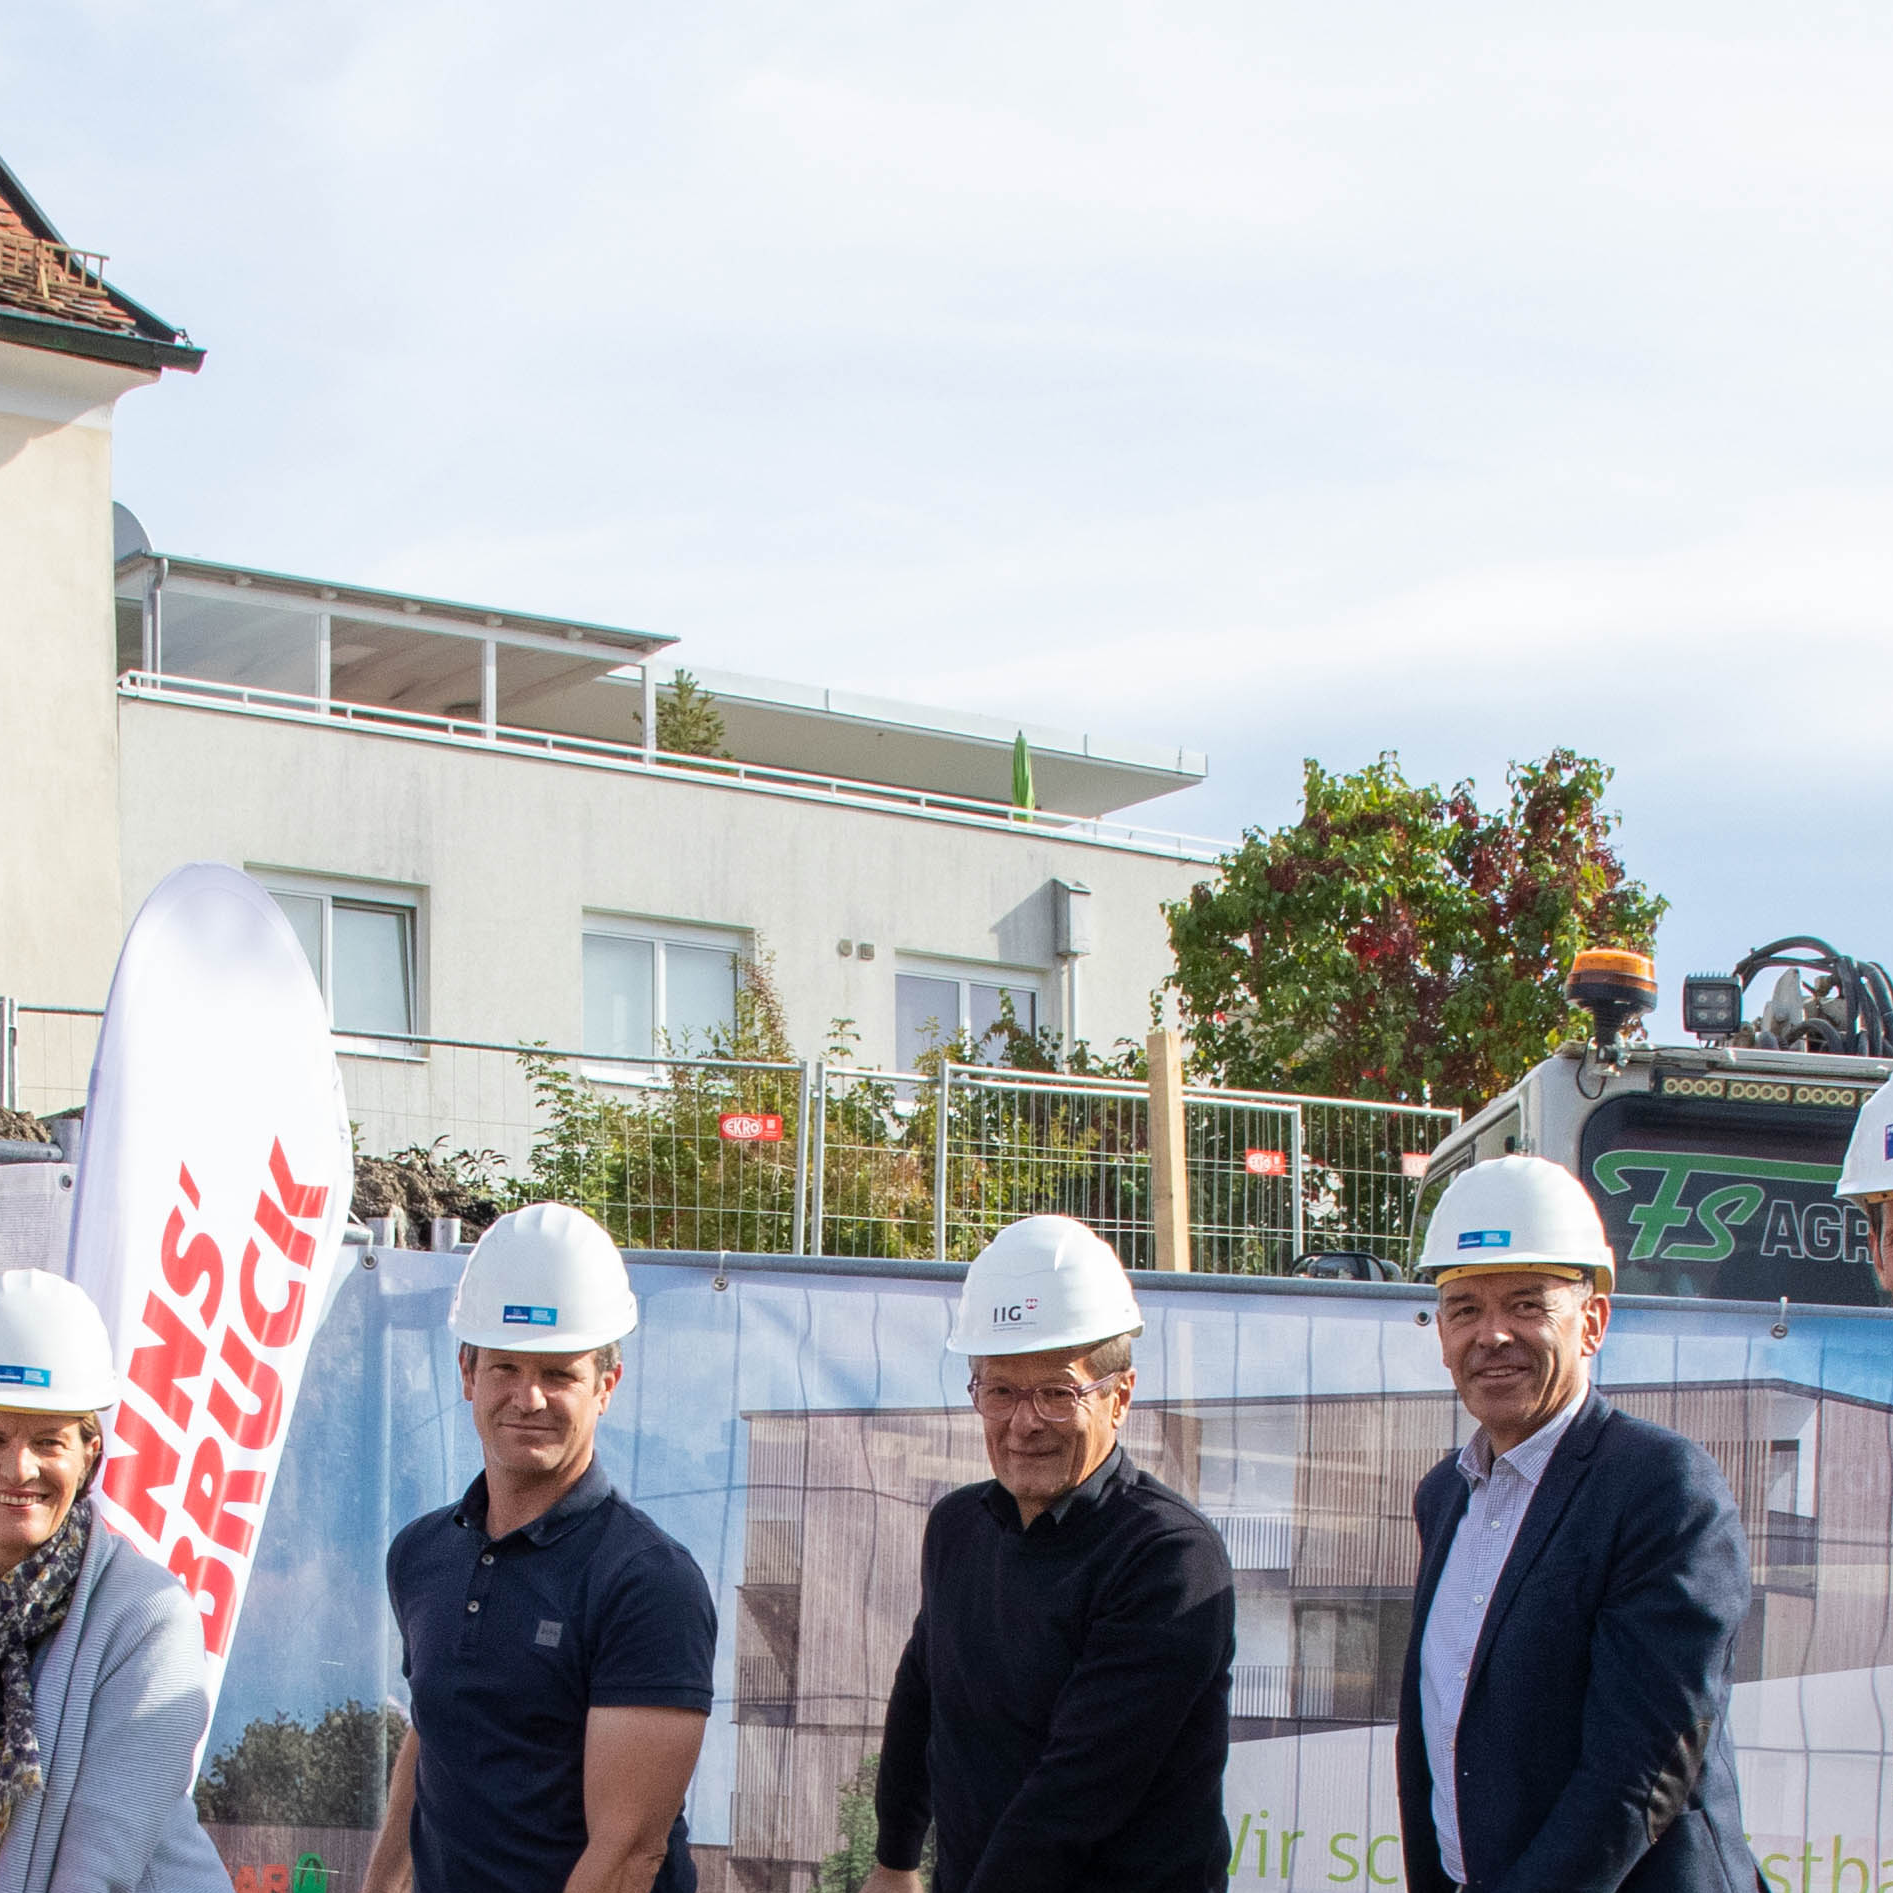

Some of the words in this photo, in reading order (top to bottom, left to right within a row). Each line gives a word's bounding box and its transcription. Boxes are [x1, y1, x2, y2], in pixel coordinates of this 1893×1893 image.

[102, 1160, 225, 1547] NNS'
[169, 1135, 329, 1659] BRUCK
[993, 1305, 1021, 1323] IIG
